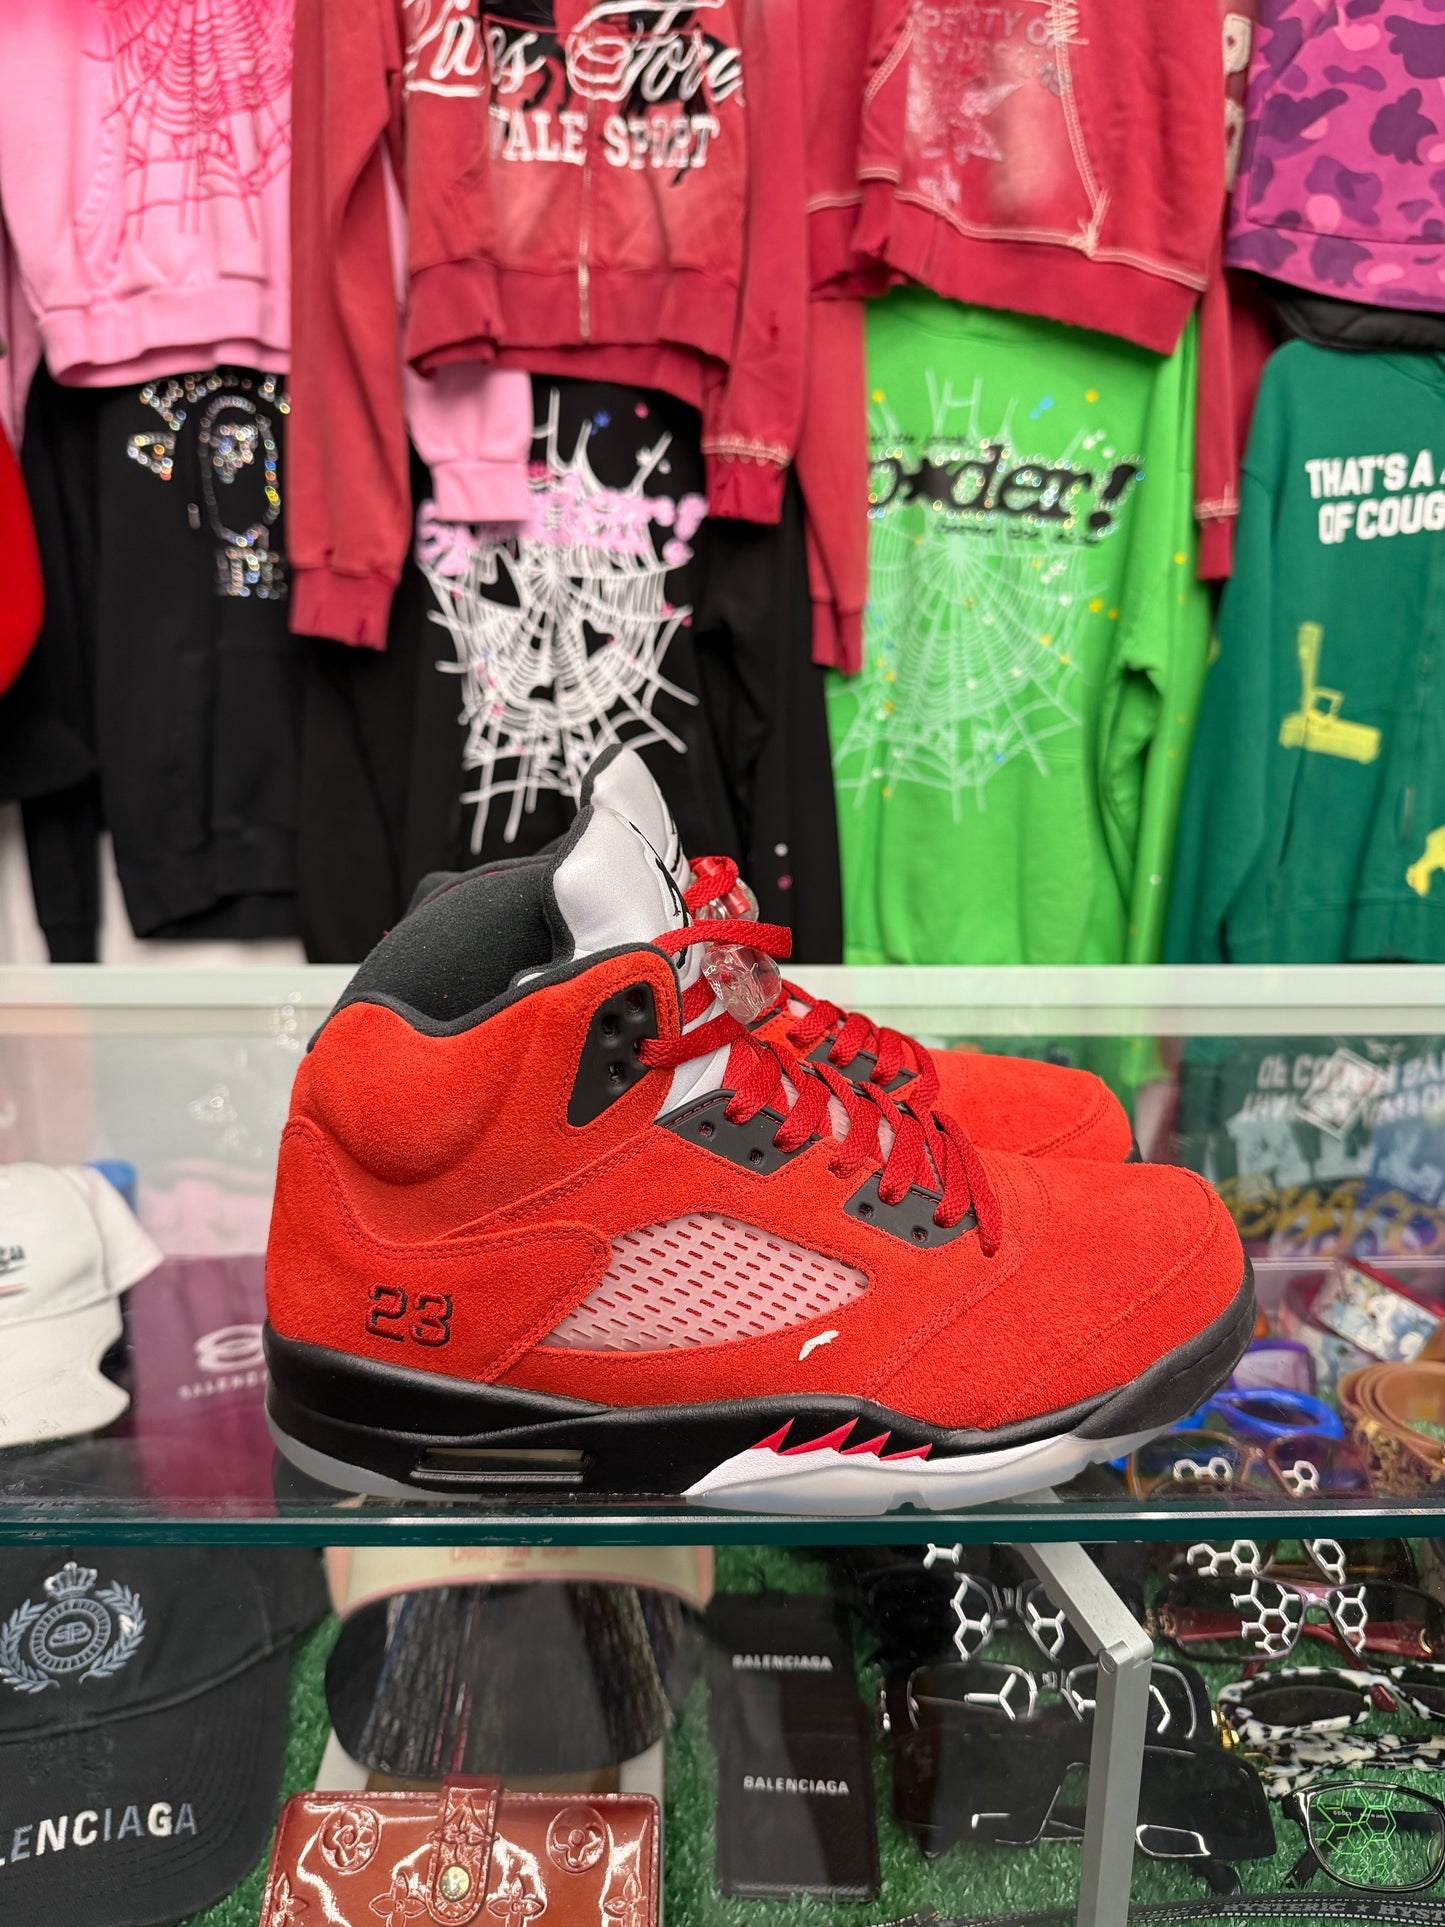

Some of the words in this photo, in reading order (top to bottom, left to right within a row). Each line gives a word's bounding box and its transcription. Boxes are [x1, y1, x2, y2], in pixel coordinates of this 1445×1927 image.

[603, 113, 721, 170] SPORT
[1304, 452, 1409, 499] THAT'S
[1409, 448, 1434, 489] A
[1318, 501, 1355, 545] OF
[365, 1282, 454, 1348] 23
[732, 1653, 834, 1672] BALENCIAGA
[743, 1775, 850, 1797] BALENCIAGA
[0, 1802, 198, 1867] ENCIAGA
[1223, 1902, 1347, 1914] HYSTERIC
